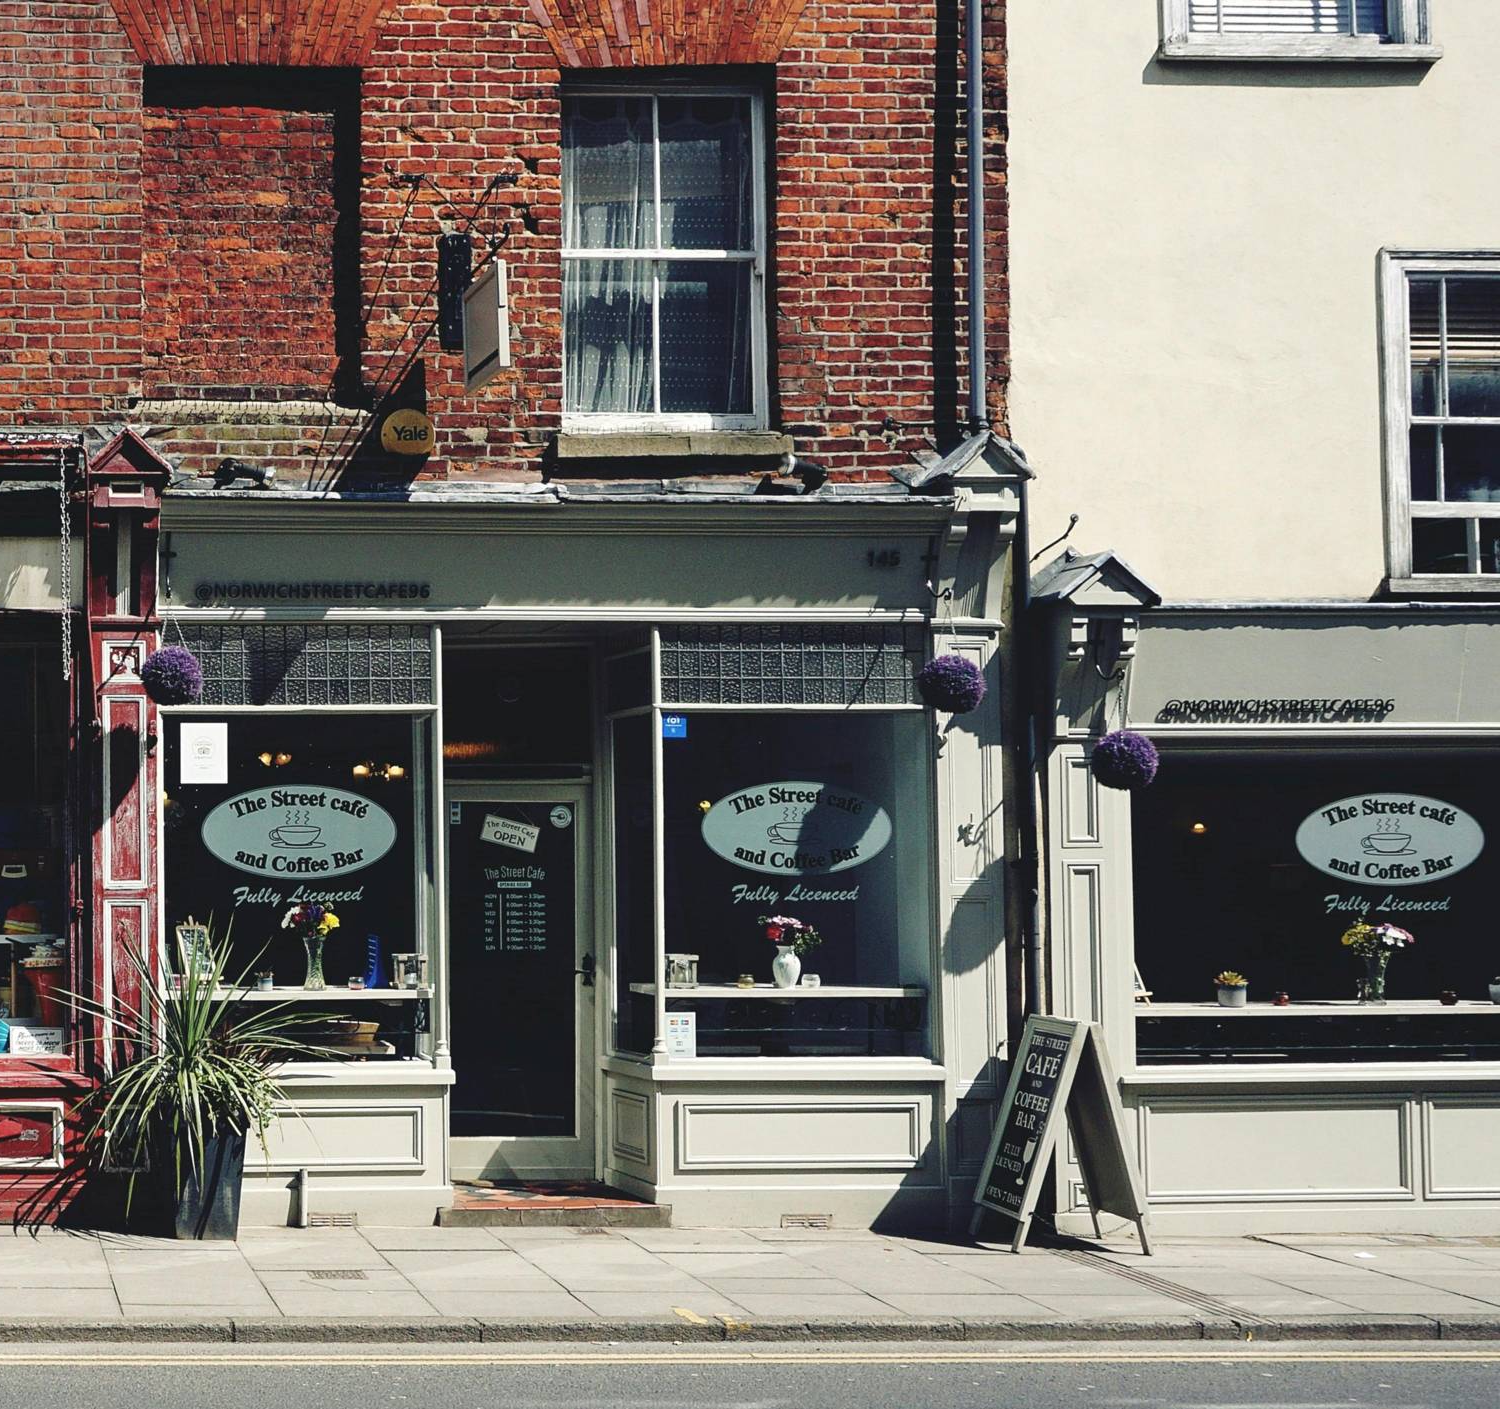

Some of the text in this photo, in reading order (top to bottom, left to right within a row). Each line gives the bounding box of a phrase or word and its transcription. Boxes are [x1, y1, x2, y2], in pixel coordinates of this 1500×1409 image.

[392, 425, 428, 441] Yale
[868, 551, 901, 567] 145
[195, 583, 430, 599] @NORWICHSTREETCAFE96
[1164, 699, 1395, 713] @NORWICHSTREETCAFE96
[229, 790, 370, 819] The Street café
[728, 787, 863, 815] The Street café
[1322, 799, 1458, 826] The Street café
[486, 820, 500, 828] The
[501, 821, 521, 832] Street
[493, 830, 526, 847] OPEN
[235, 848, 363, 873] and Coffee Bar
[734, 845, 860, 869] and Coffee Bar
[1328, 855, 1454, 880] and Coffee Bar
[484, 865, 546, 880] The Street Cafe
[233, 885, 364, 908] Fully Licenced
[731, 884, 860, 905] Fully Licenced
[1323, 894, 1451, 915] Fully Licenced
[1031, 1034, 1070, 1051] THE STREET
[1025, 1053, 1061, 1079] CAFÉ
[1014, 1090, 1050, 1113] COFFEE
[1015, 1111, 1036, 1131] BAR
[1003, 1142, 1022, 1156] FULLY
[995, 1155, 1022, 1173] LICENCED
[986, 1184, 1002, 1200] OPEN
[1007, 1190, 1023, 1208] DAYS
